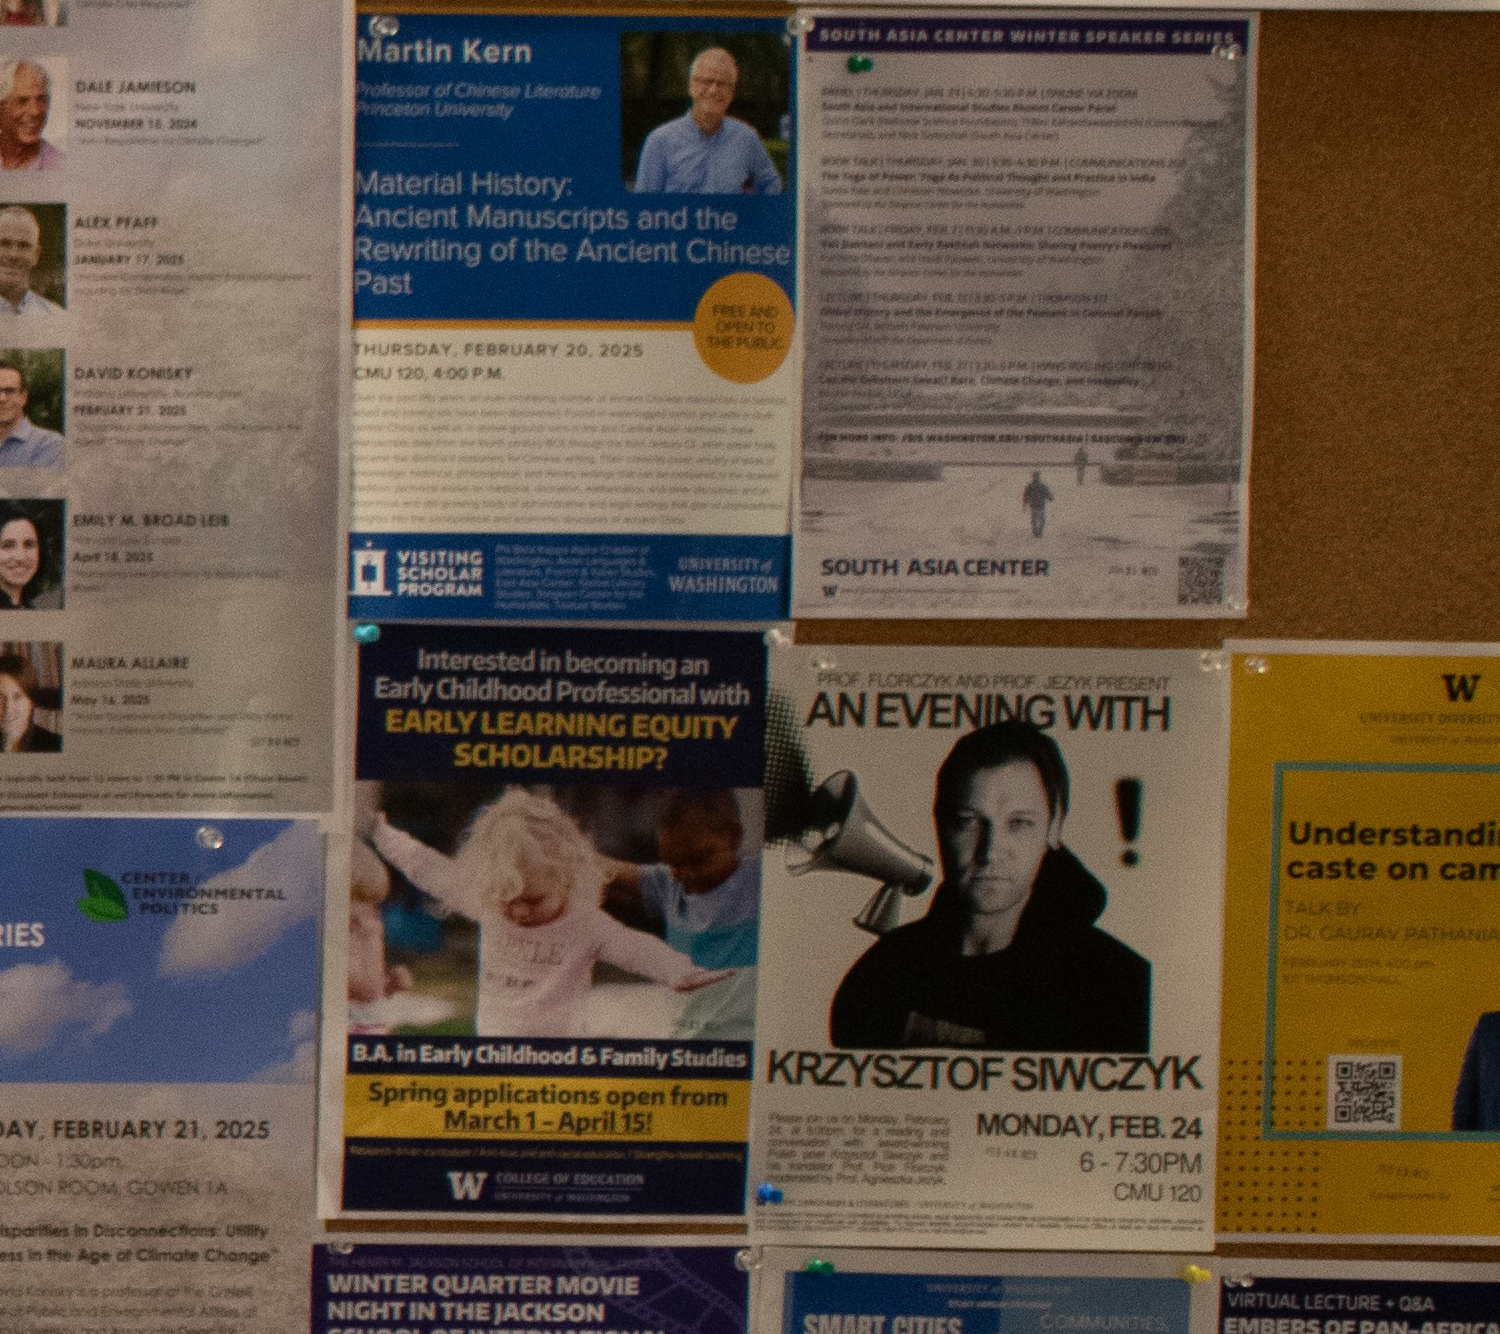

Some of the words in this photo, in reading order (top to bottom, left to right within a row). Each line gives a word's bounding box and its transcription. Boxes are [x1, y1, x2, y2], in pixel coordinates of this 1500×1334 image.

[358, 38, 452, 65] Martin
[463, 39, 533, 66] Kern
[386, 709, 476, 734] EARLY
[482, 711, 626, 738] LEARNING
[632, 713, 738, 740] EQUITY
[454, 743, 667, 770] SCHOLARSHIP?
[769, 1051, 1004, 1090] KRZYSZTOF
[1012, 1054, 1203, 1092] SIWCZYK
[53, 1120, 167, 1141] FEBRUARY
[173, 1120, 208, 1144] 21,
[217, 1120, 271, 1141] 2025
